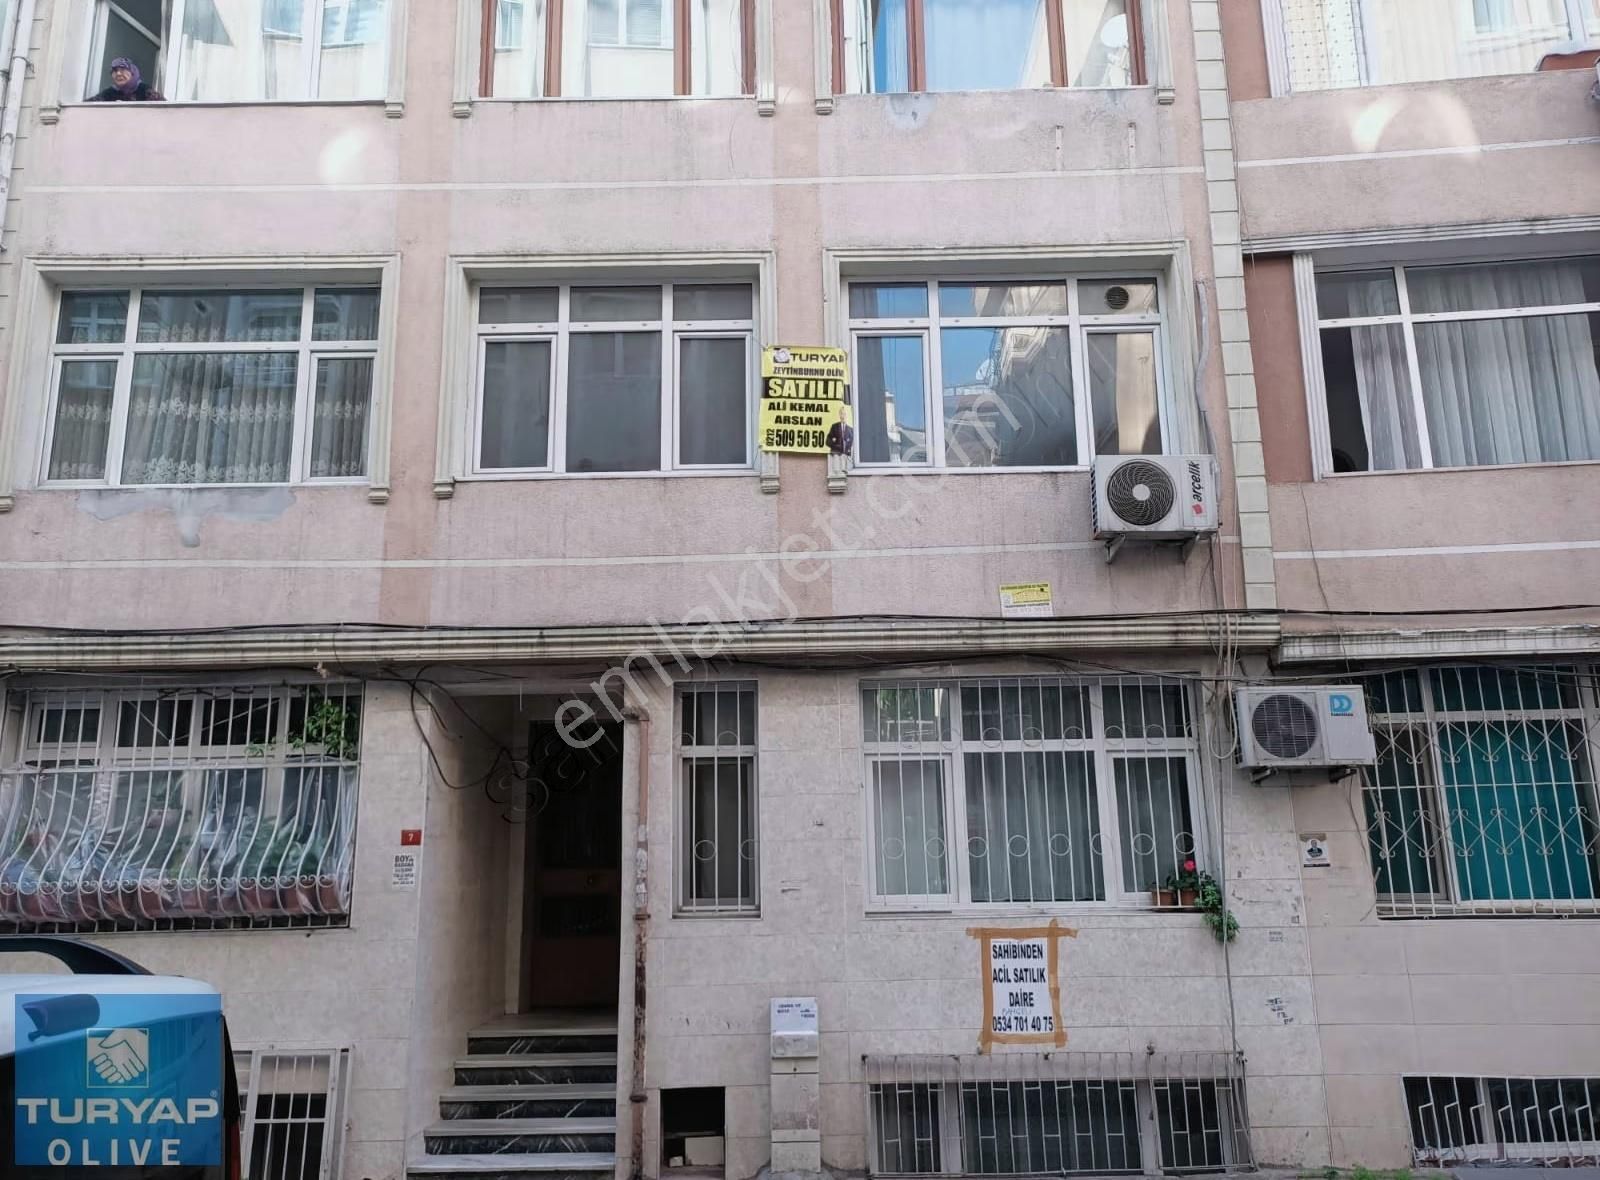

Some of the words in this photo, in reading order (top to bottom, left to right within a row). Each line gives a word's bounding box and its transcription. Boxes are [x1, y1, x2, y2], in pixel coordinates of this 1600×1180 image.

[768, 401, 787, 411] ALİ
[789, 403, 830, 413] KEMAL
[774, 415, 822, 426] ARSLAN
[766, 428, 774, 446] 0212
[776, 429, 795, 447] 509
[797, 430, 810, 447] 50
[812, 431, 825, 448] 50
[1188, 460, 1204, 502] arçelik
[408, 833, 414, 842] 7
[992, 942, 1043, 959] SAHİBİNDEN
[993, 964, 1011, 983] ACİL
[1013, 968, 1045, 983] SATILIK
[1009, 988, 1034, 1007] DAİRE
[992, 1016, 1012, 1031] 0534
[1014, 1016, 1028, 1031] 701
[1031, 1016, 1041, 1031] 40
[1043, 1016, 1053, 1031] 75
